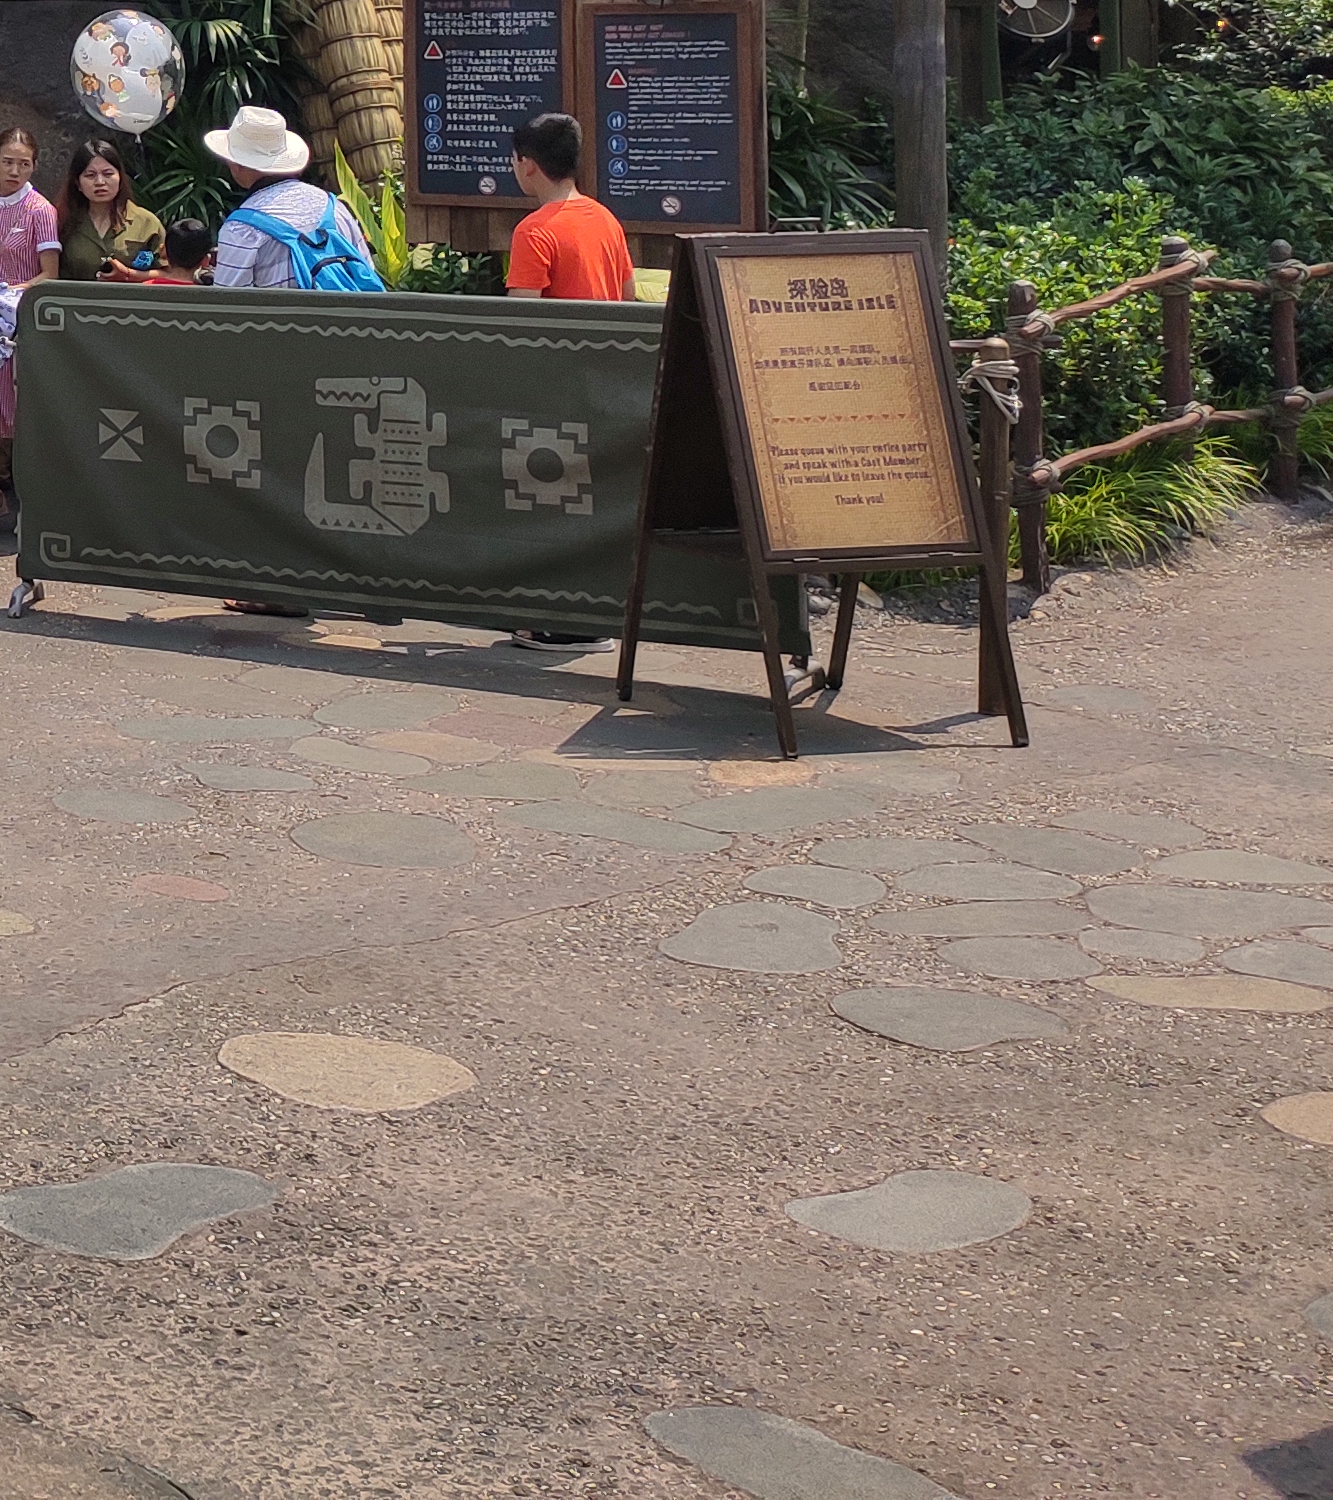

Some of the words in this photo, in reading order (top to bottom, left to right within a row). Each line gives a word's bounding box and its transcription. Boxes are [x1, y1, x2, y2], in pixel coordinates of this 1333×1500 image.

[787, 277, 849, 300] 探险岛
[749, 298, 854, 313] ADVENTURE
[857, 294, 897, 311] ISLE
[826, 444, 848, 454] with
[850, 445, 870, 455] your
[901, 442, 928, 454] party
[783, 460, 801, 470] and
[802, 459, 828, 471] speak
[829, 458, 851, 468] with
[861, 457, 881, 467] Cast
[883, 456, 920, 466] Member
[788, 475, 803, 485] you
[805, 474, 830, 483] would
[832, 472, 850, 482] like
[862, 471, 884, 481] leave
[887, 470, 902, 480] the
[834, 494, 865, 506] Thank
